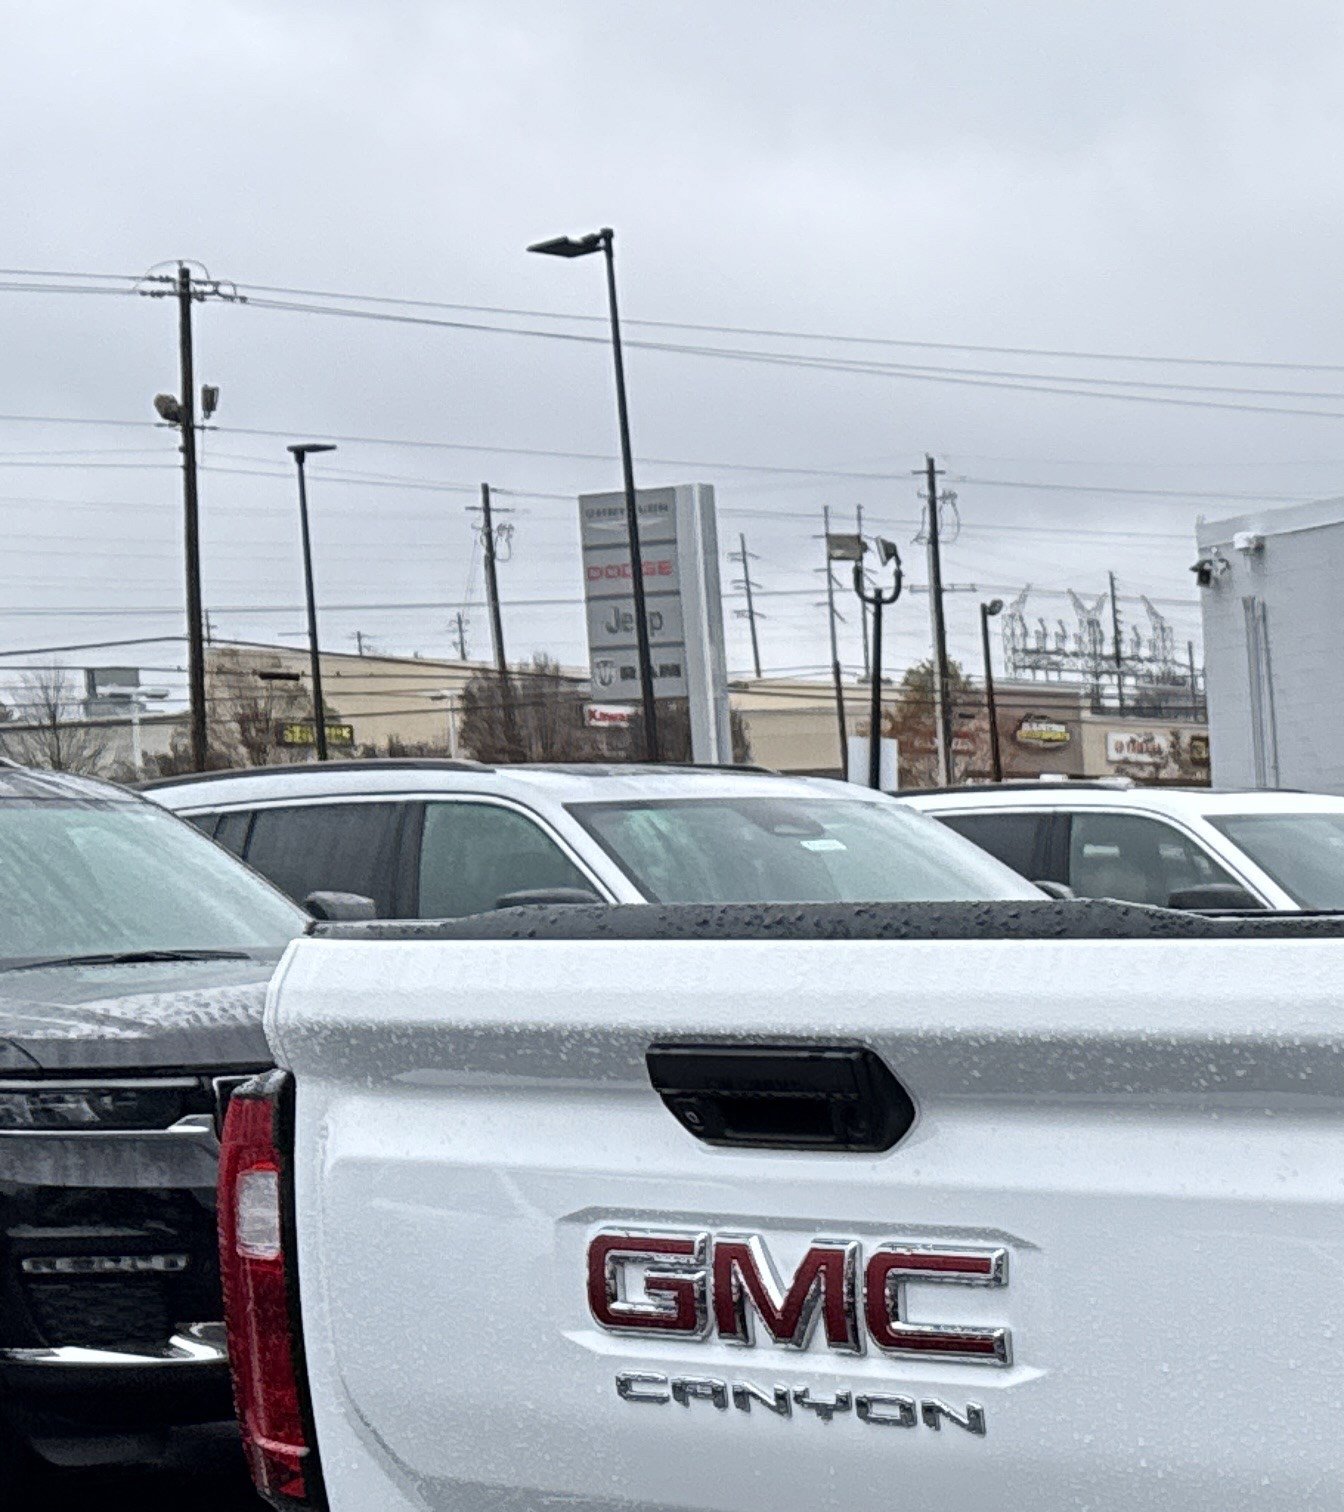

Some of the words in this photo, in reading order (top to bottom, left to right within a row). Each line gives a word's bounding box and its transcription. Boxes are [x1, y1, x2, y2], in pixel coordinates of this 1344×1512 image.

[605, 605, 664, 637] Jep
[586, 1225, 1014, 1368] GMC
[615, 1369, 988, 1436] CANYON
